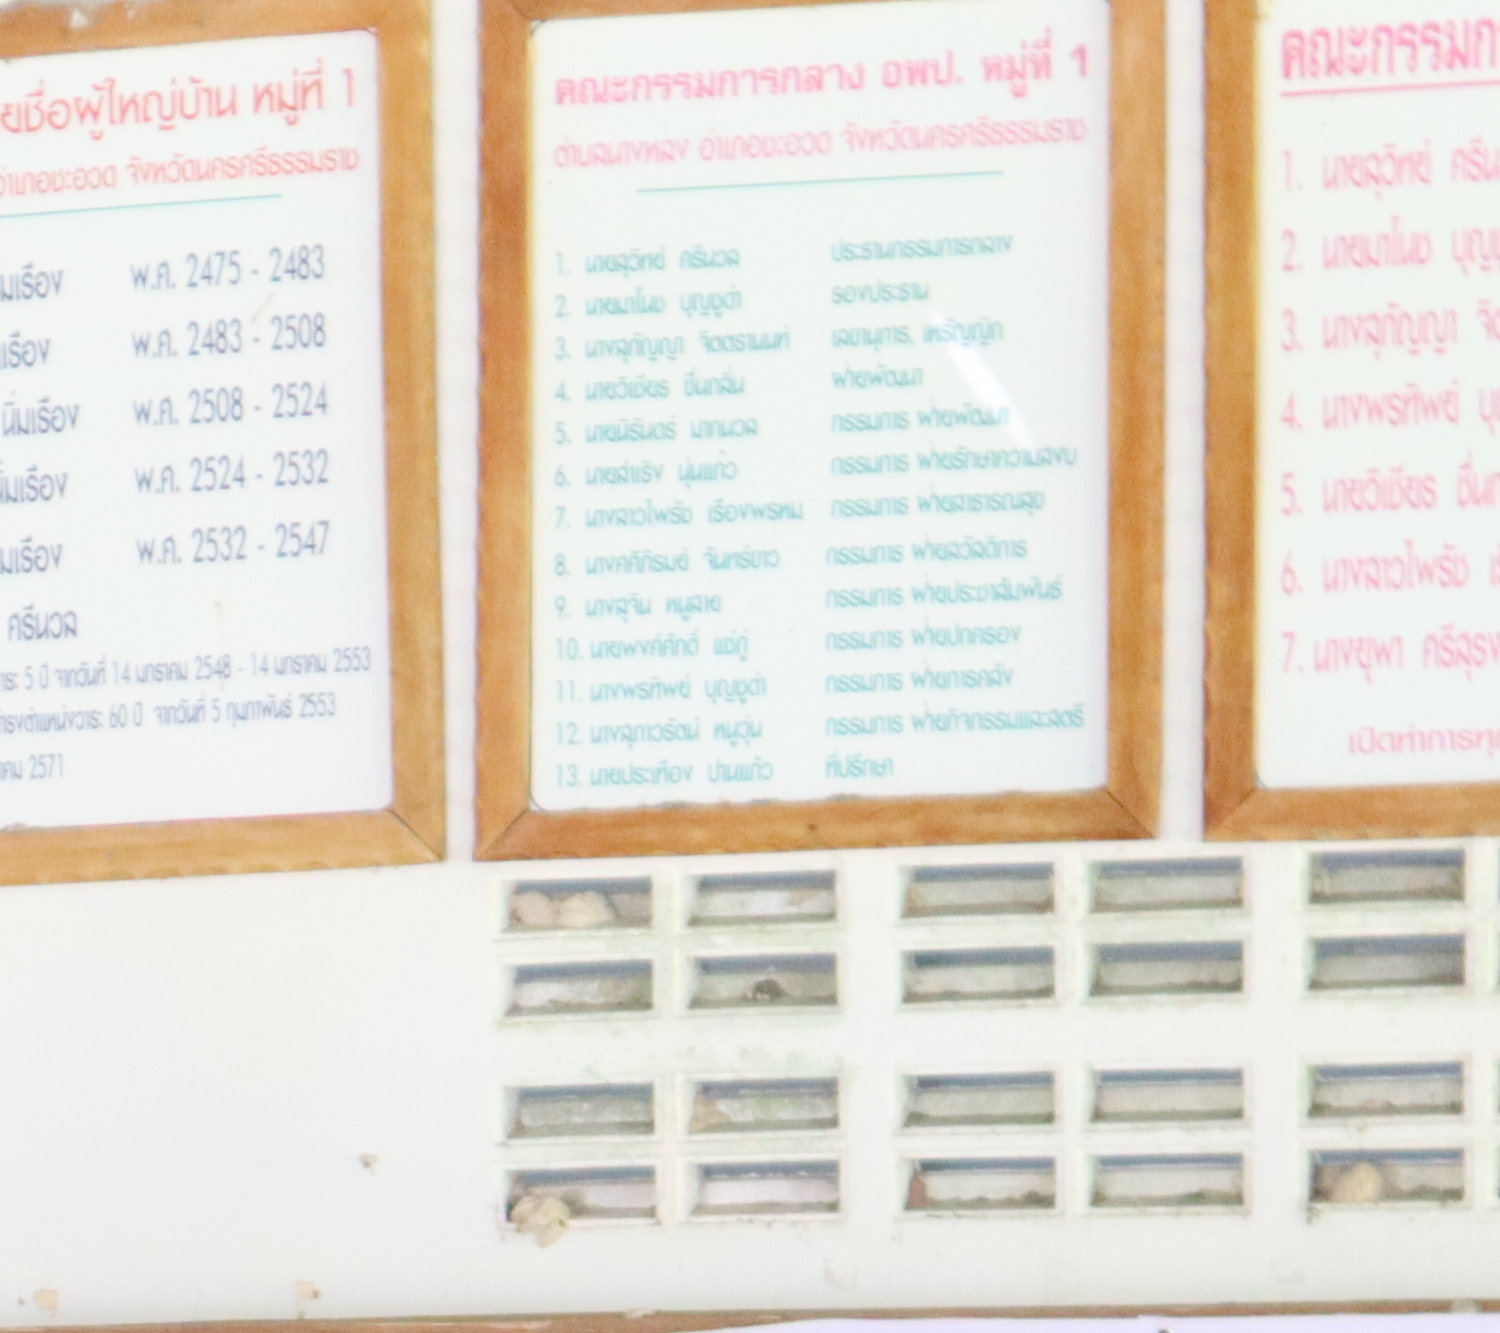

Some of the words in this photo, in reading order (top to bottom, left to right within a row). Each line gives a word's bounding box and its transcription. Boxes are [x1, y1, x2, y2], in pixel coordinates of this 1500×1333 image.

[981, 26, 1052, 99] หมู่ที่
[1069, 43, 1088, 77] 1
[252, 56, 325, 127] หมู่ที่
[341, 67, 355, 107] 1
[129, 259, 176, 290] พ.ศ.
[184, 249, 242, 290] 2475
[268, 243, 325, 283] 2483
[1281, 228, 1302, 272] 2.
[131, 327, 177, 358] พ.ศ.
[186, 316, 242, 357] 2483
[269, 311, 326, 351] 2508
[1281, 307, 1302, 352] 3.
[1, 390, 80, 437] นิ่มเรือง
[132, 395, 179, 426] พ.ศ.
[187, 385, 244, 425] 2508
[270, 380, 329, 420] 2524
[1280, 391, 1302, 430] 4.
[133, 463, 180, 494] พ.ศ.
[189, 454, 246, 493] 2524
[272, 447, 329, 488] 2532
[1281, 471, 1302, 516] 5.
[135, 534, 182, 564] พ.ศ.
[190, 524, 247, 564] 2532
[274, 519, 330, 559] 2547
[1280, 551, 1302, 595] 6.
[24, 665, 34, 690] 5
[113, 660, 131, 684] 14
[250, 652, 269, 676] 14
[332, 645, 370, 673] 2553
[1281, 630, 1303, 672] 7.
[108, 703, 127, 728] 60
[211, 697, 220, 723] 5
[298, 690, 336, 718] 2553
